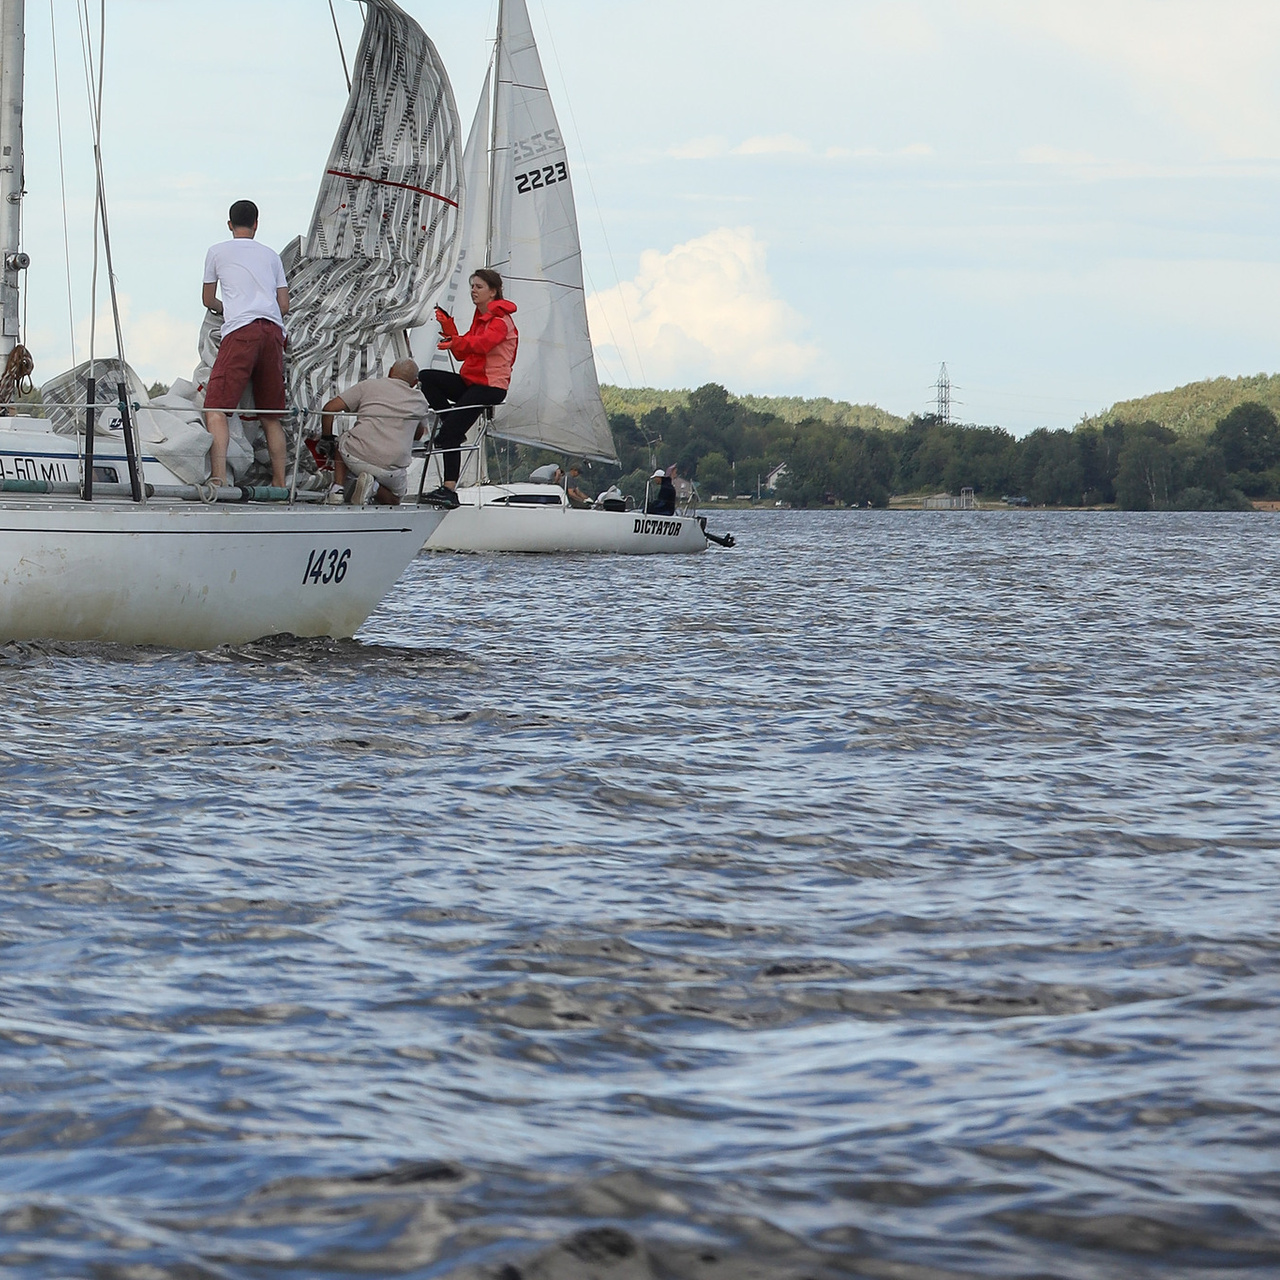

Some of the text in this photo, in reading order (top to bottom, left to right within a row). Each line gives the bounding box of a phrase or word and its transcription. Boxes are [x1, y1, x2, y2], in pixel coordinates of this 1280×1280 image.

[514, 161, 568, 195] 2223
[633, 519, 682, 537] DICTATOR
[302, 548, 352, 585] 1436
